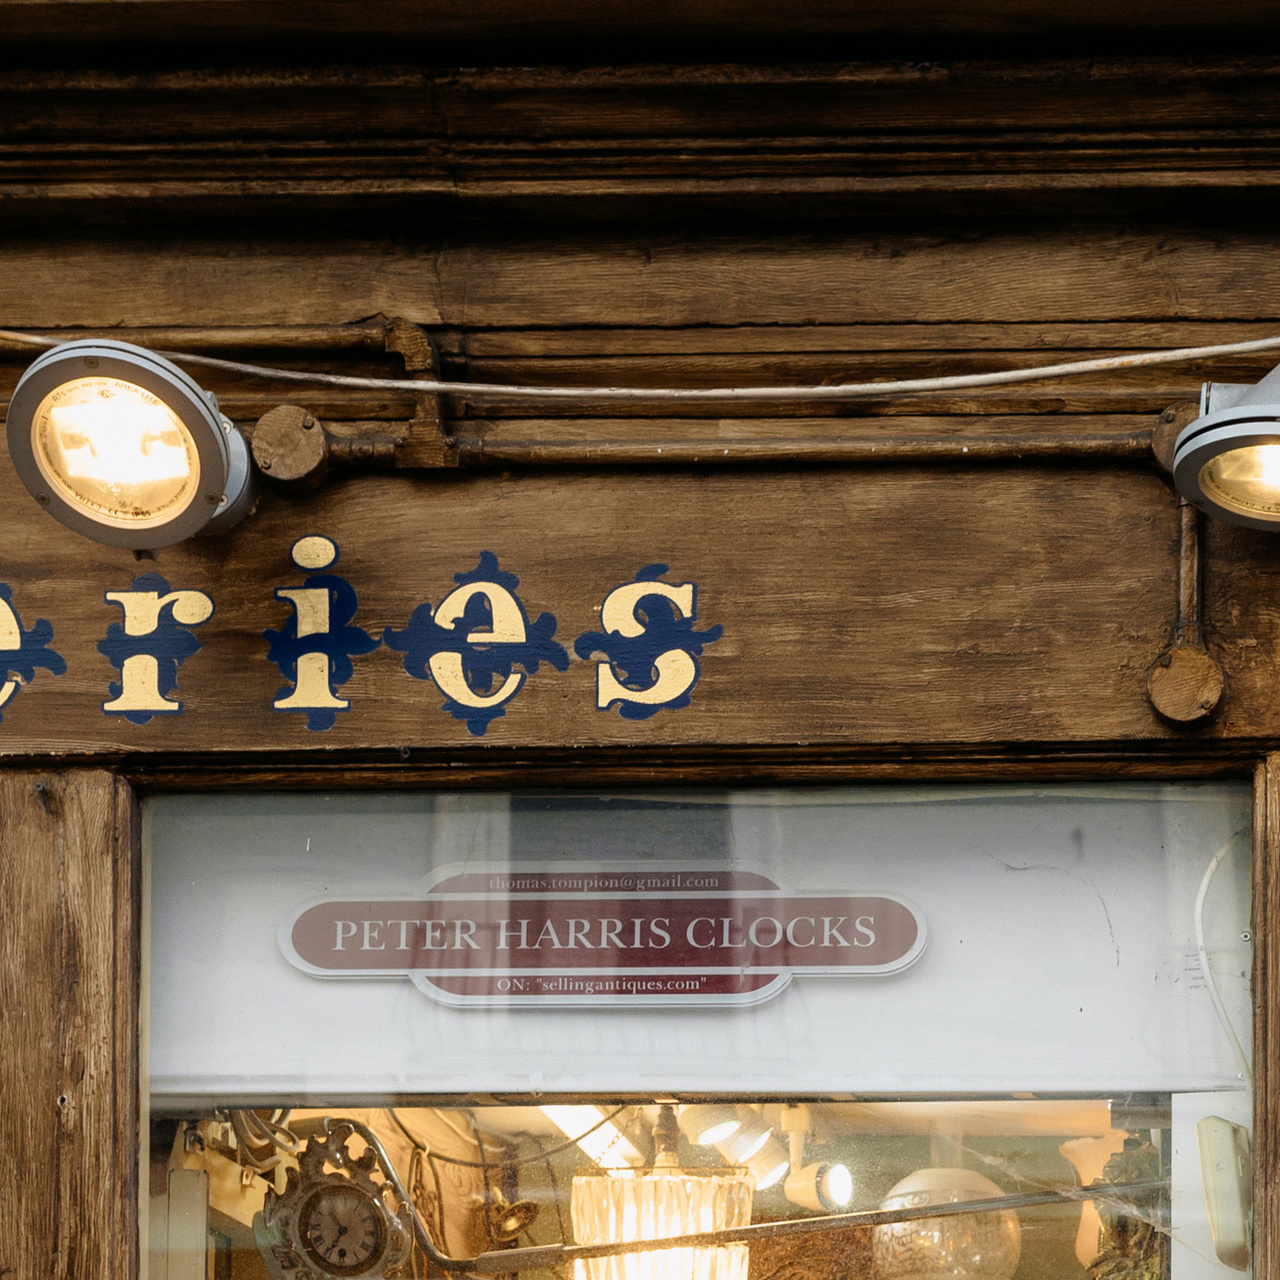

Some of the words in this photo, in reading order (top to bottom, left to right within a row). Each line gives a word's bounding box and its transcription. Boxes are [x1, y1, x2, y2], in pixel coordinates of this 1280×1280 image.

[0, 535, 697, 711] ries
[489, 874, 719, 893] thomas.tompion@gmail.com
[332, 919, 481, 950] PETER
[496, 917, 671, 950] HARRIS
[686, 915, 876, 949] CLOCKS
[497, 978, 530, 991] ON:
[536, 977, 707, 994] "sellingantiques.com"
